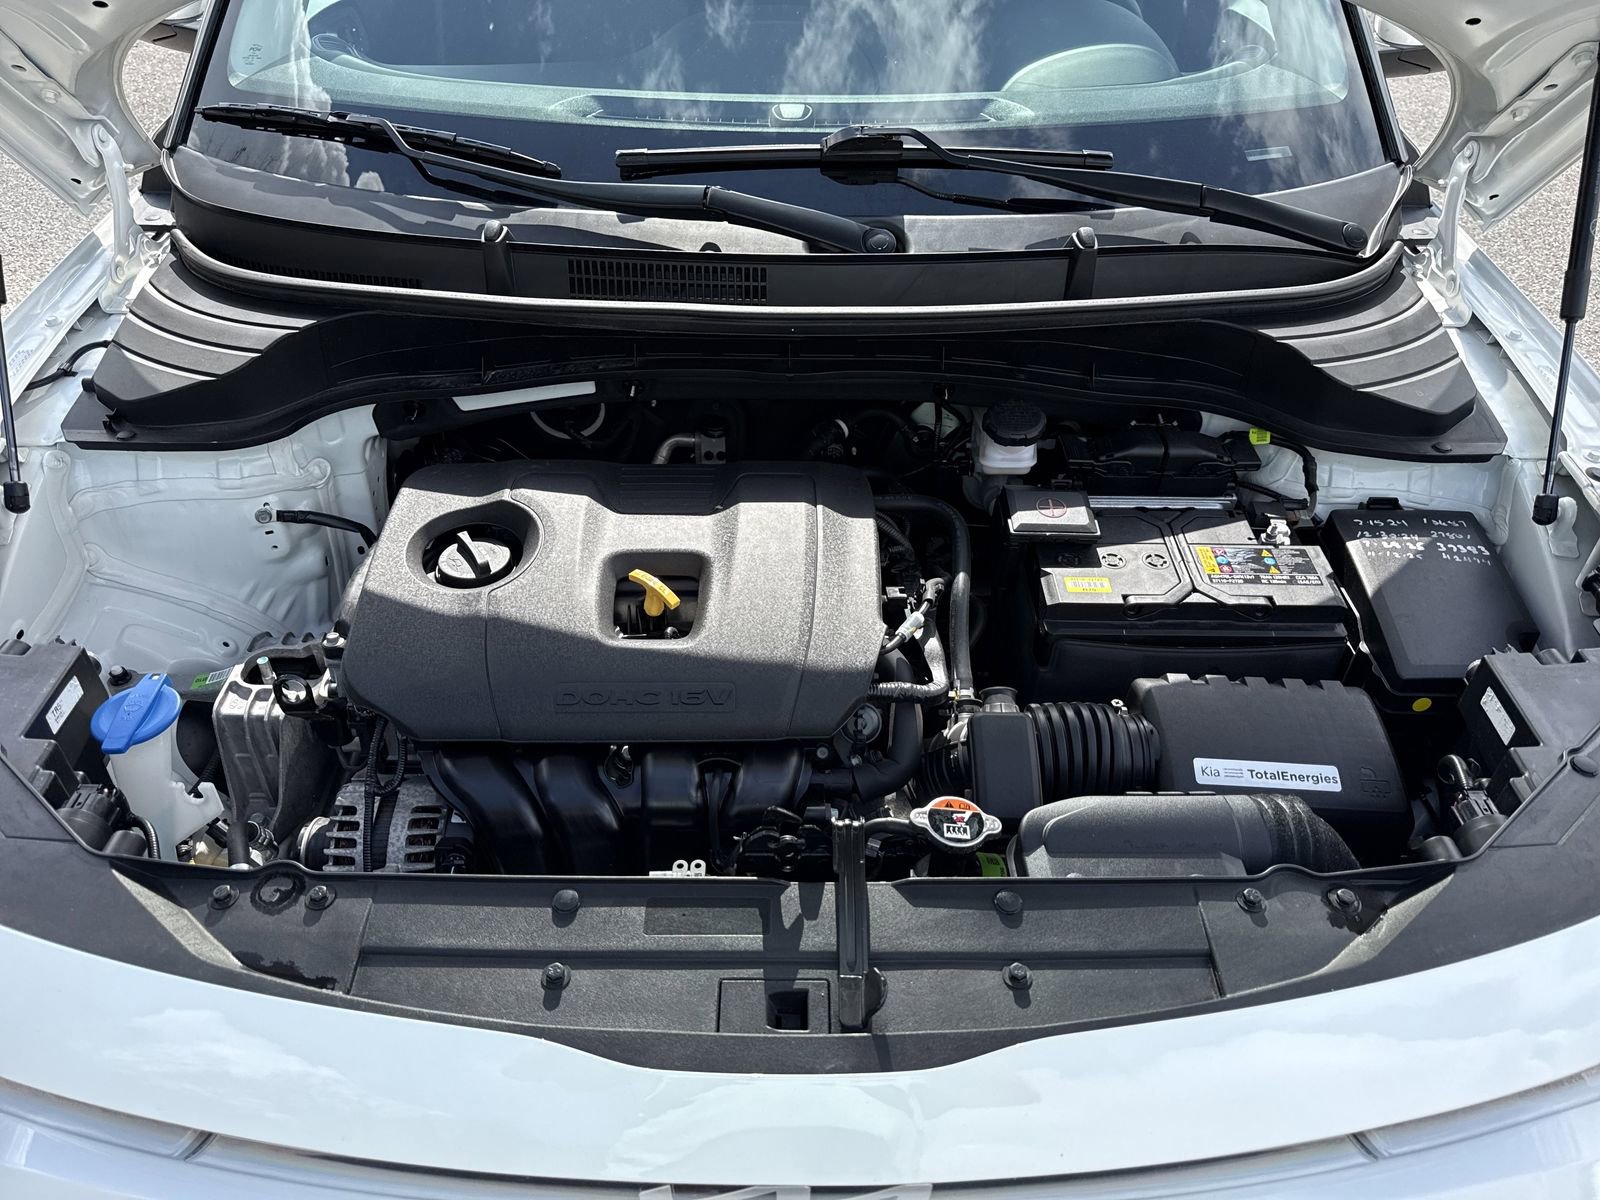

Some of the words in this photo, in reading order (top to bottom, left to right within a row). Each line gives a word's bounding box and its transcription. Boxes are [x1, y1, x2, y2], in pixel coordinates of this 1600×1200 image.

[556, 690, 662, 707] DOHC
[670, 690, 733, 707] 16V
[1200, 766, 1221, 778] Kia
[1247, 769, 1339, 785] TotalEnergies
